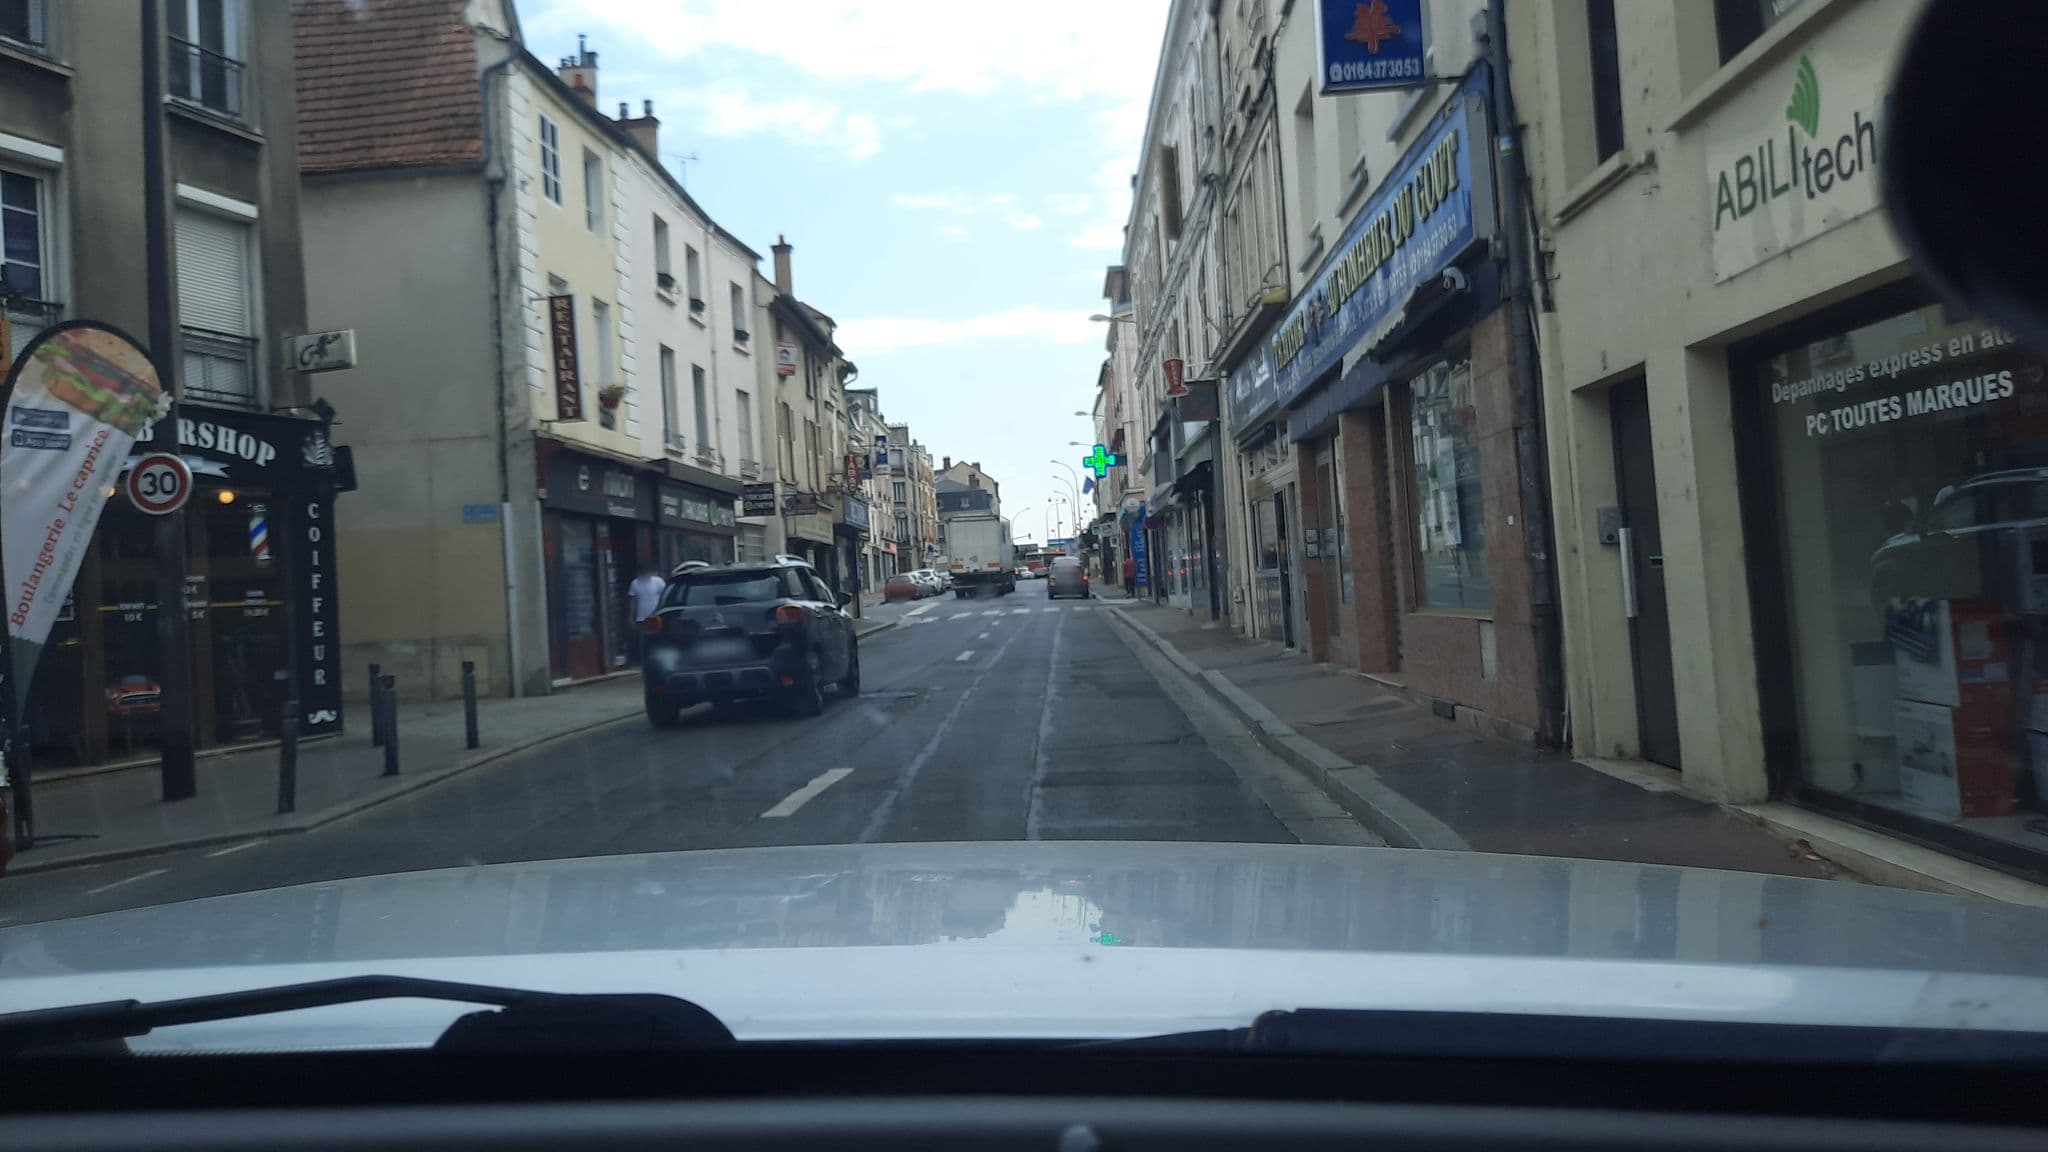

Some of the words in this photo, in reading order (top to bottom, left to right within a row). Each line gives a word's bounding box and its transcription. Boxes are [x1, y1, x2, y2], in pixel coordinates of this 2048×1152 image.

[1336, 209, 1395, 304] BONHEUR
[1391, 182, 1415, 248] DU
[553, 297, 577, 418] RESTAURANT
[1805, 414, 1829, 437] PC
[1831, 395, 1902, 432] TOUTES
[1906, 370, 2015, 417] MARQUES
[1868, 342, 1943, 379] express
[1948, 333, 1975, 358] en
[9, 517, 66, 629] Boulangerie
[57, 490, 79, 513] Le
[72, 428, 111, 491] caprice
[142, 471, 177, 496] 30
[307, 502, 327, 686] COIFFEUR
